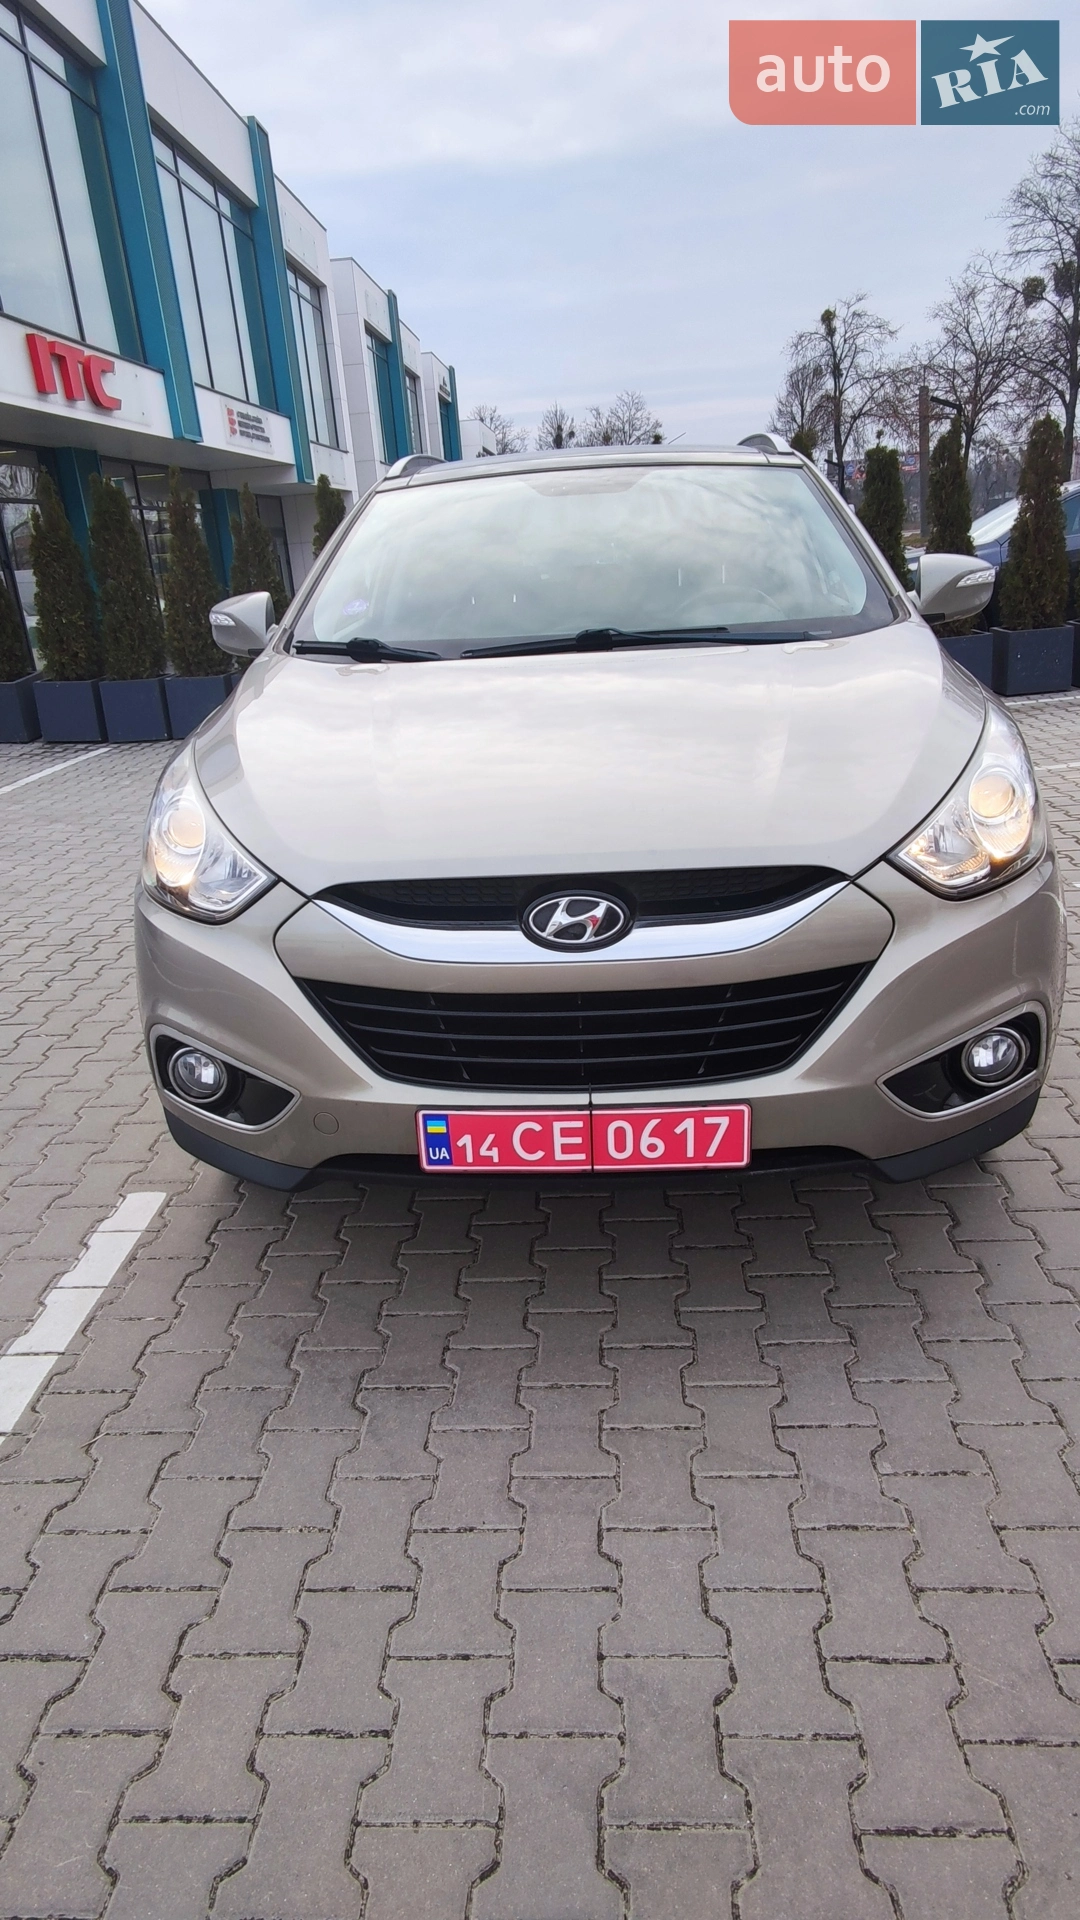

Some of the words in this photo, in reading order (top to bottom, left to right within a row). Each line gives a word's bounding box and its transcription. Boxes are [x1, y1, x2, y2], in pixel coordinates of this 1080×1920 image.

[26, 333, 122, 410] ITC
[429, 1147, 450, 1160] UA
[456, 1133, 499, 1163] 14
[512, 1121, 586, 1161] CE
[606, 1116, 730, 1160] 0617
